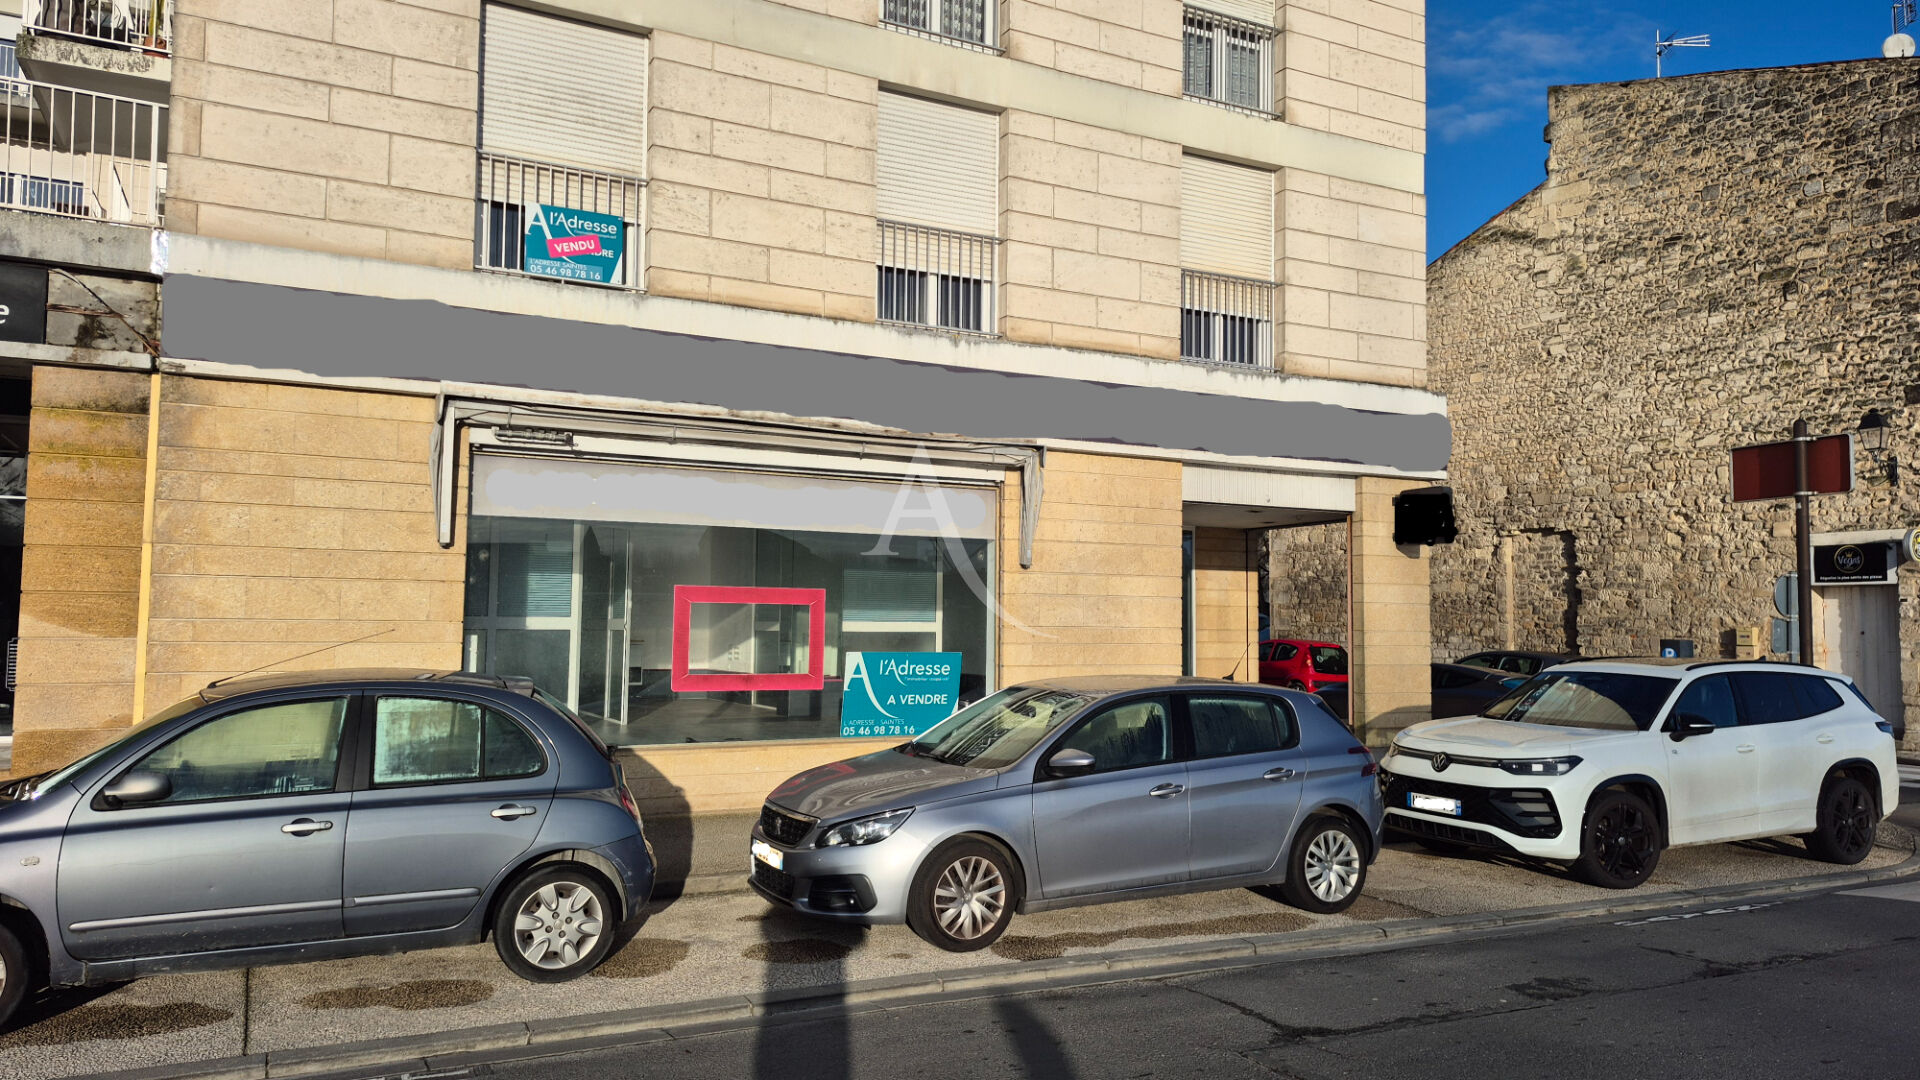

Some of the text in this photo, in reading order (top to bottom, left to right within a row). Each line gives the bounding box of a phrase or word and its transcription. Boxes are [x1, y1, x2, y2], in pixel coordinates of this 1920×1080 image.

[549, 211, 618, 236] l'Adresse
[554, 239, 595, 253] VENDU
[530, 264, 601, 280] 05 46 98 78 16
[879, 659, 951, 681] l'Adresse
[887, 694, 948, 705] A VENDRE
[843, 725, 915, 736] 05 46 98 78 16
